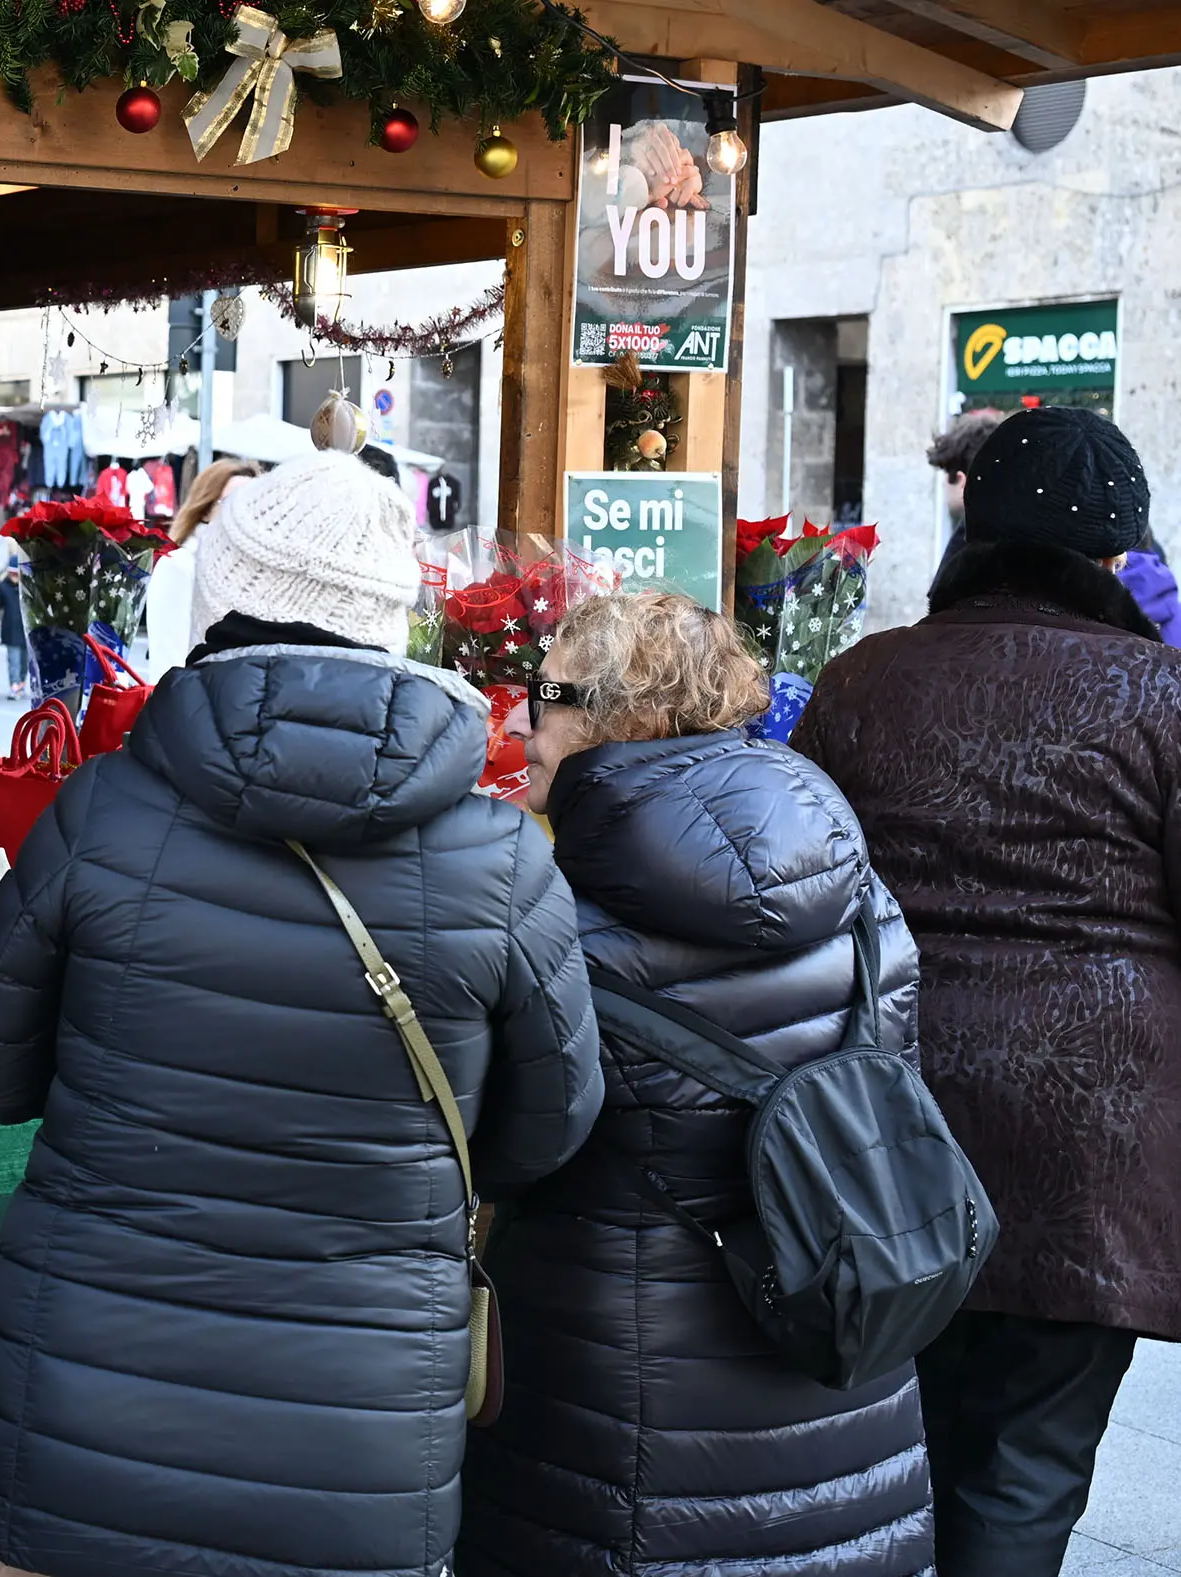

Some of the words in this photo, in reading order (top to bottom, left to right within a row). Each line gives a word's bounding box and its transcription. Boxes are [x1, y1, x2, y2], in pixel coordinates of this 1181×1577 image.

[606, 124, 621, 195] I
[606, 204, 706, 281] YOU
[608, 335, 660, 351] 5X1000
[609, 324, 633, 333] DONA
[634, 325, 643, 334] IL
[643, 325, 661, 335] TUO
[674, 331, 721, 361] ANT
[1003, 331, 1117, 365] SPACCA
[583, 489, 632, 531] Se
[639, 489, 684, 531] mi
